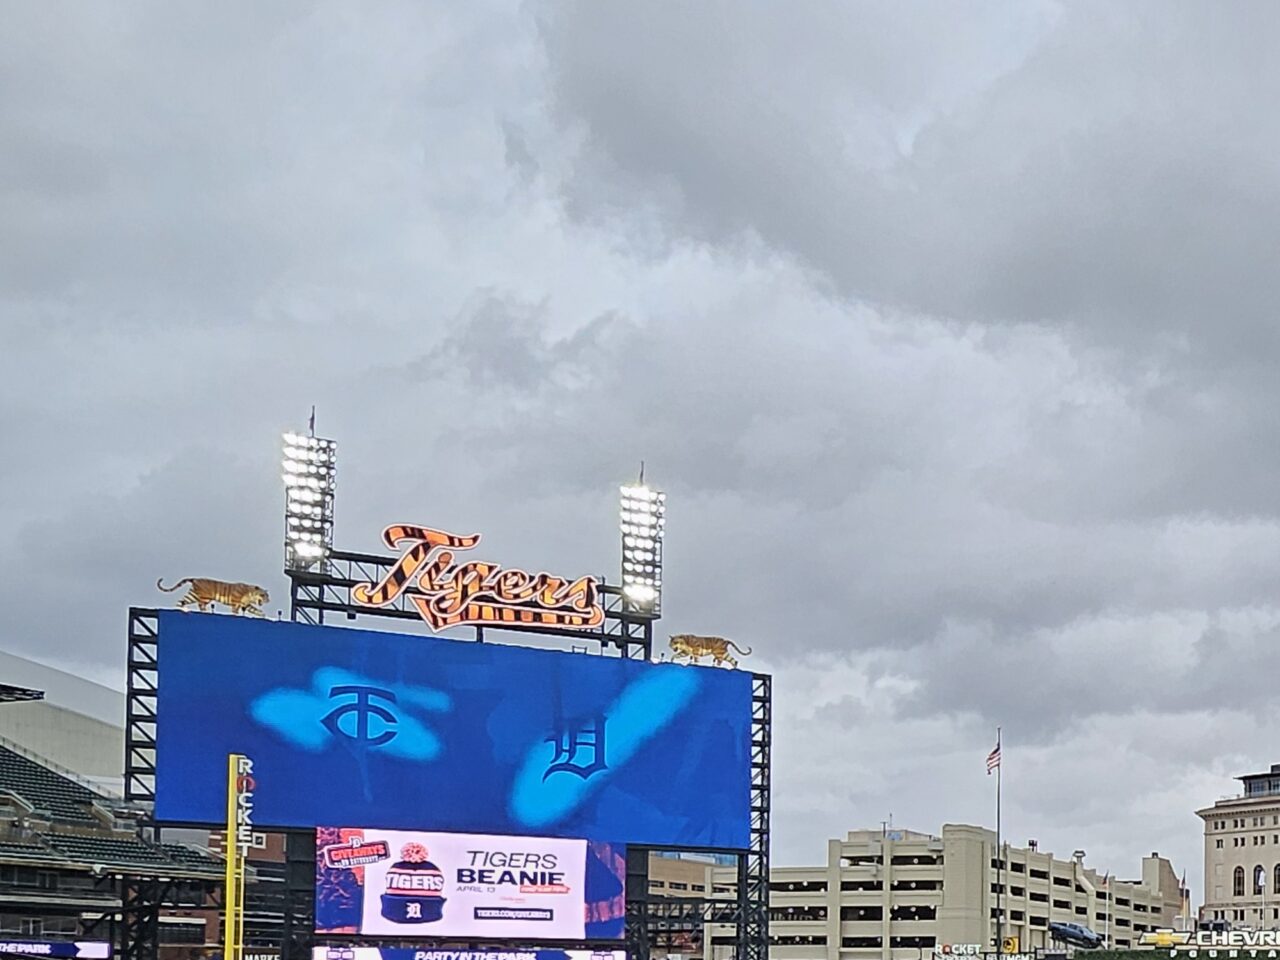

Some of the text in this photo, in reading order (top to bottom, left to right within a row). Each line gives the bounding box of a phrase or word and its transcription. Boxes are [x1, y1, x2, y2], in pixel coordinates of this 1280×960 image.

[353, 523, 605, 632] Tigers
[236, 758, 256, 857] ROCKET
[467, 851, 558, 869] TIGERS
[385, 873, 444, 890] TIGERS
[456, 868, 565, 886] BEANIE
[414, 951, 459, 960] PARTY
[934, 944, 981, 955] ROCKET
